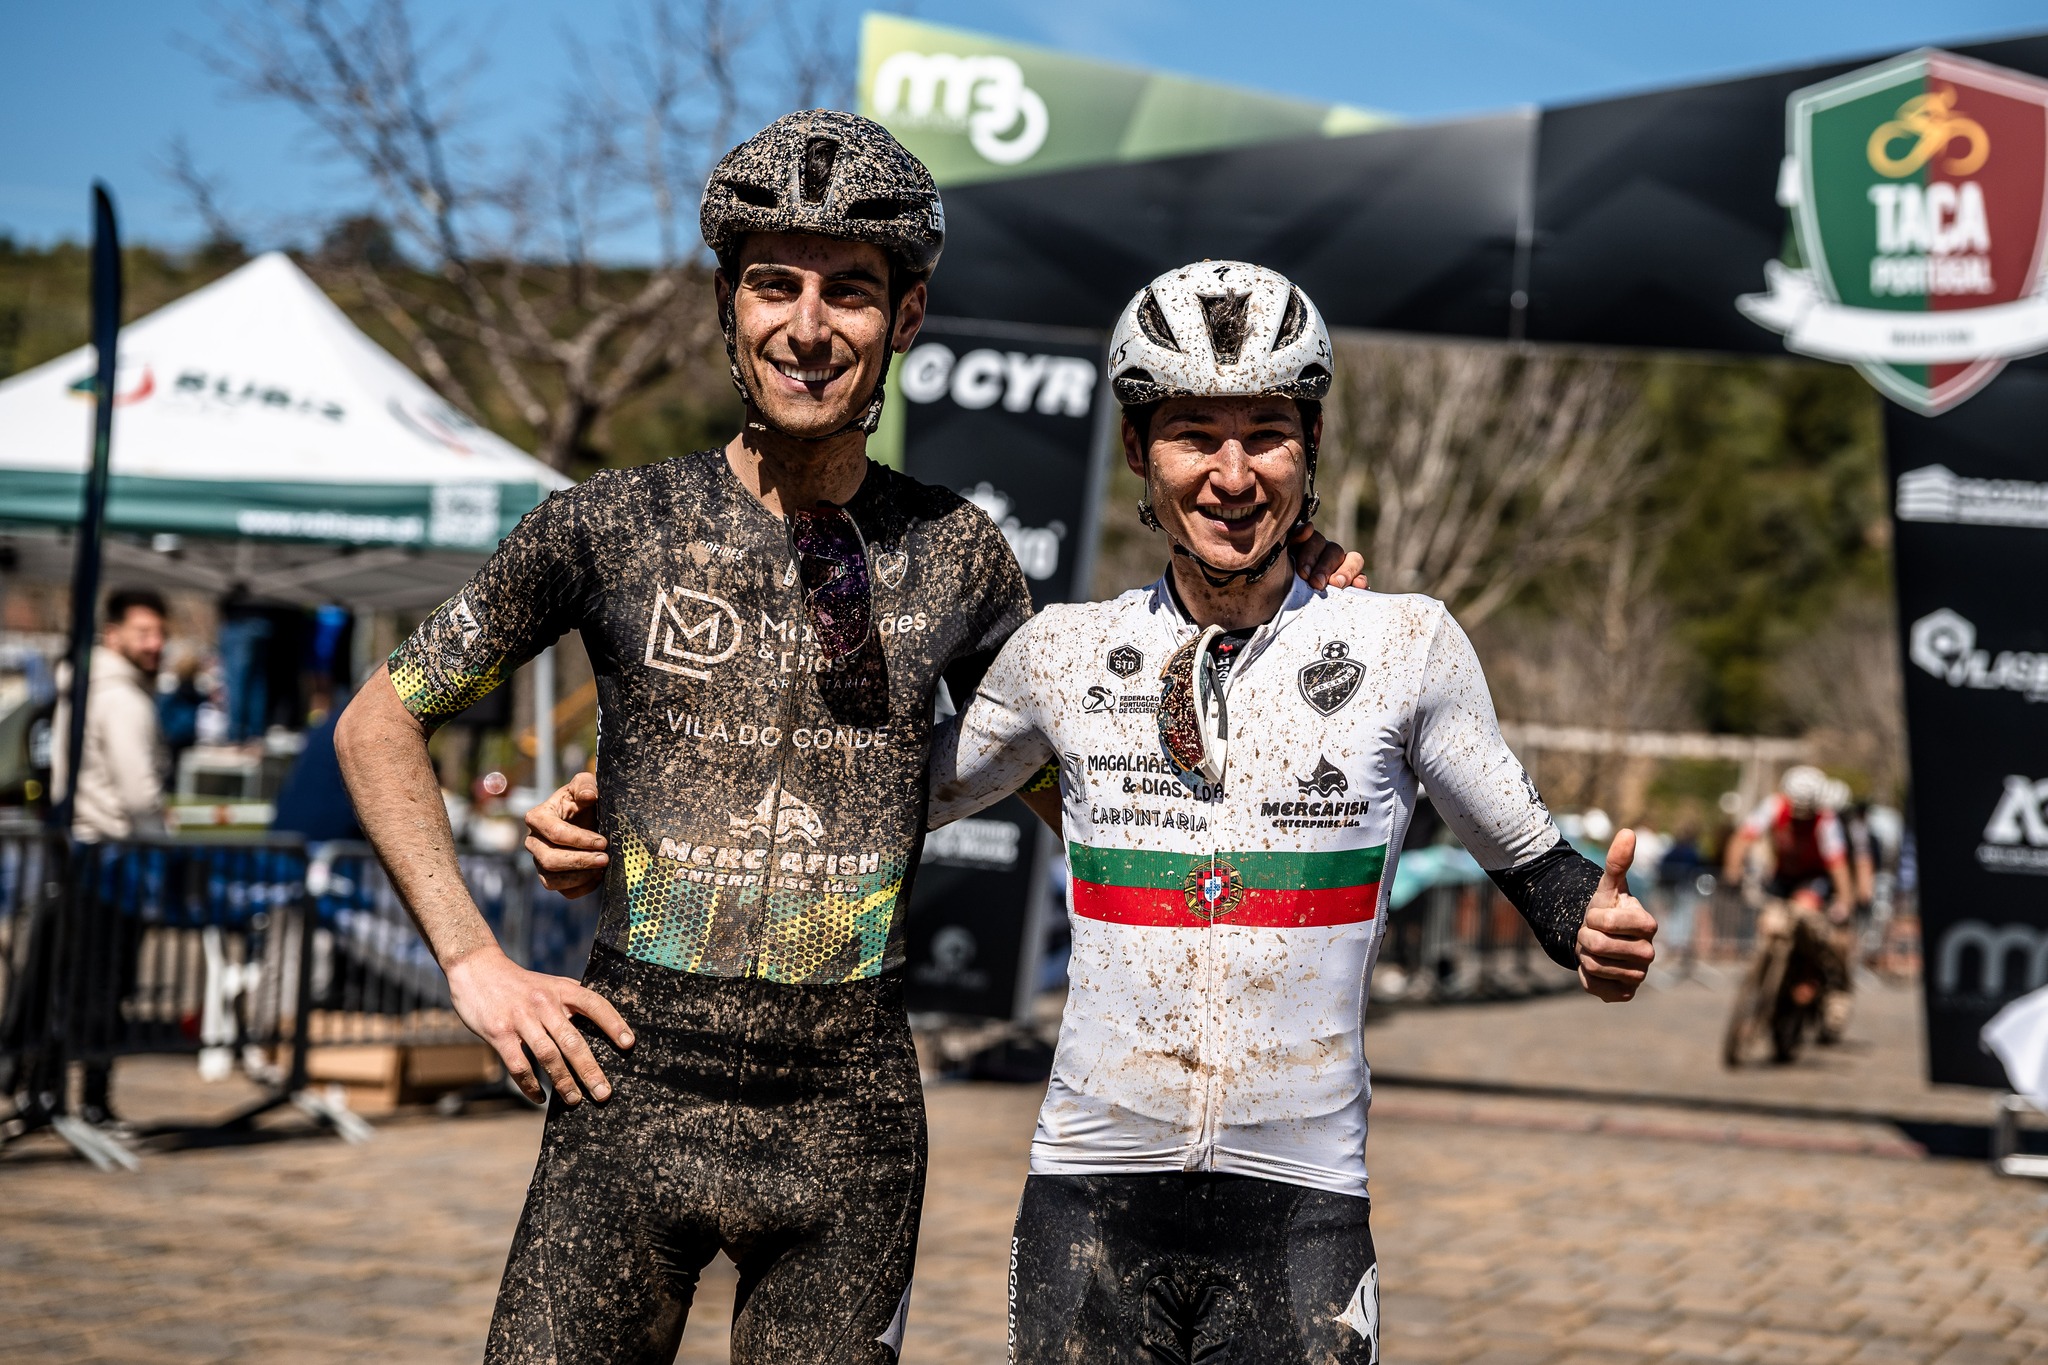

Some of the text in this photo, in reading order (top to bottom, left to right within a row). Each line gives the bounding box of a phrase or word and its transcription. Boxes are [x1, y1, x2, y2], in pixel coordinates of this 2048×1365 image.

[759, 609, 927, 649] Maães
[1115, 660, 1135, 671] STD
[1119, 694, 1160, 702] FEDERAÇÃO
[666, 709, 888, 749] VILA DO CONDE
[1088, 752, 1182, 776] MAGALHÃES
[1122, 776, 1137, 793] &
[1260, 800, 1370, 817] MERCAFISH
[1090, 806, 1208, 832] CARPINTARIA
